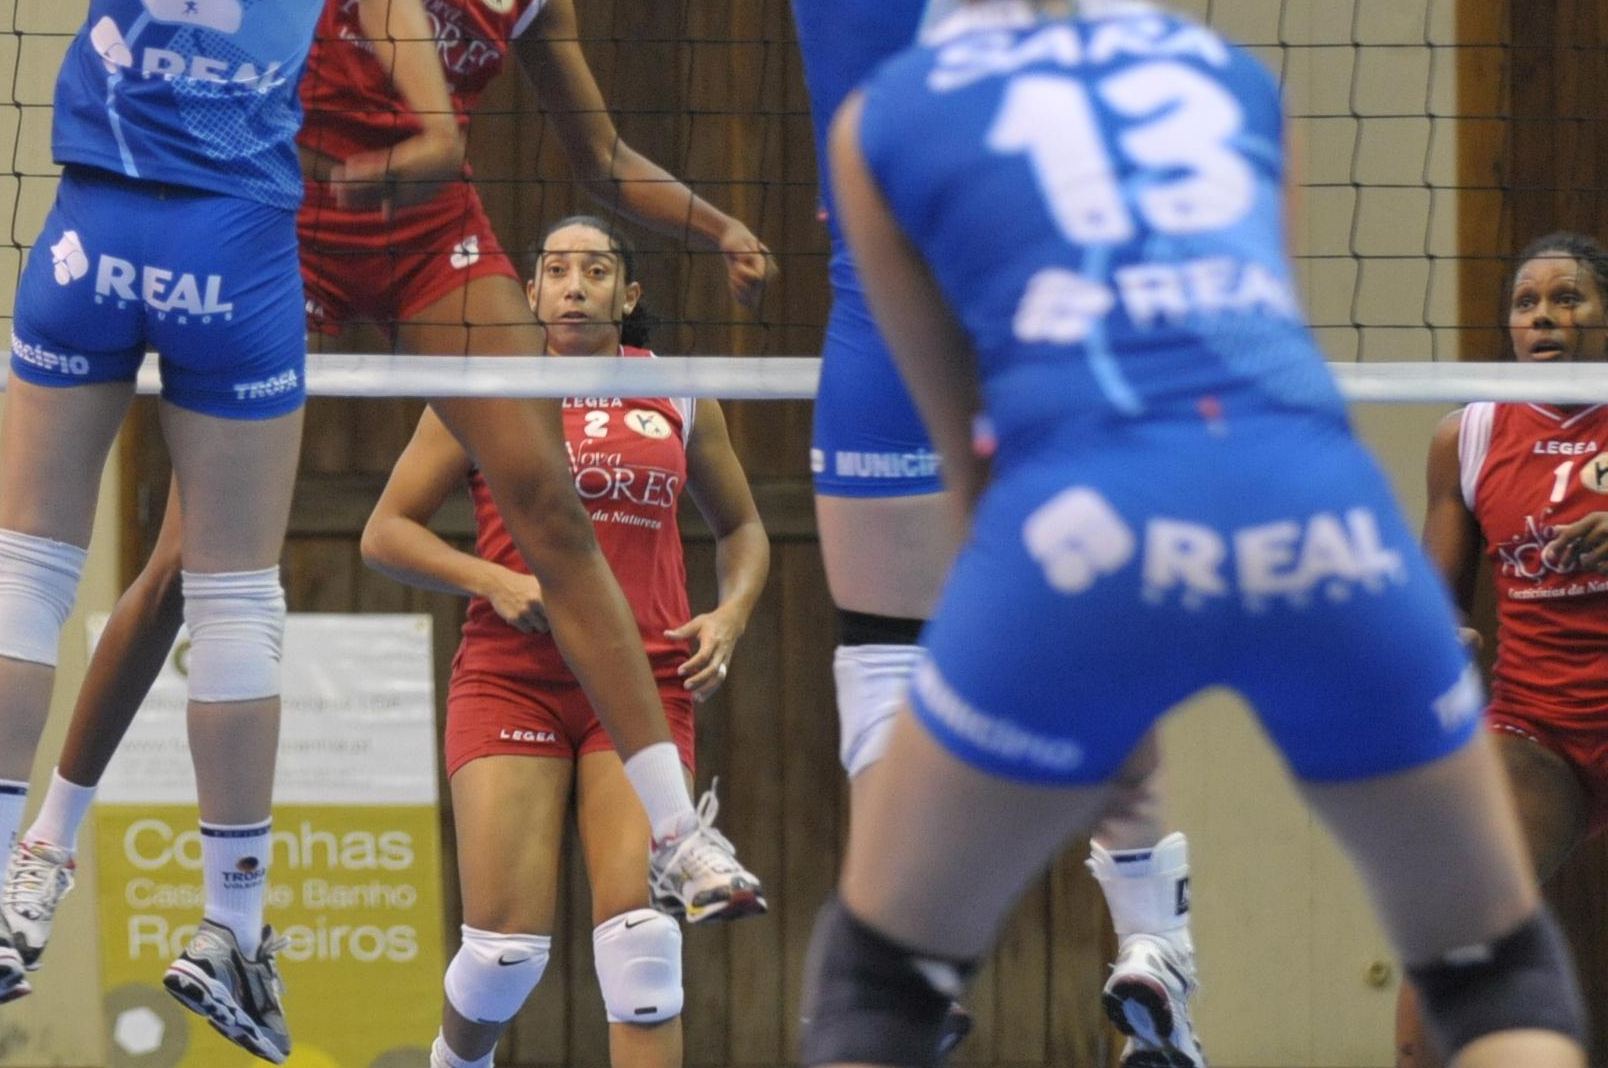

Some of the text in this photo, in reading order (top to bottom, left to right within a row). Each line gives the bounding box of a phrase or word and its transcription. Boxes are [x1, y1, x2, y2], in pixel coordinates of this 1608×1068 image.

[988, 62, 1257, 246] 13
[95, 253, 234, 315] REAL
[94, 294, 233, 325] SEUROS
[561, 397, 623, 409] LEGEA
[584, 410, 610, 439] 2
[1533, 440, 1598, 456] LEGEA
[575, 466, 680, 509] ORES
[1549, 460, 1574, 503] 1
[1143, 506, 1402, 596] REAL
[499, 729, 556, 743] LEGEA
[123, 818, 416, 872] Conhas
[303, 878, 418, 910] Banho
[128, 914, 420, 963] Roeiros
